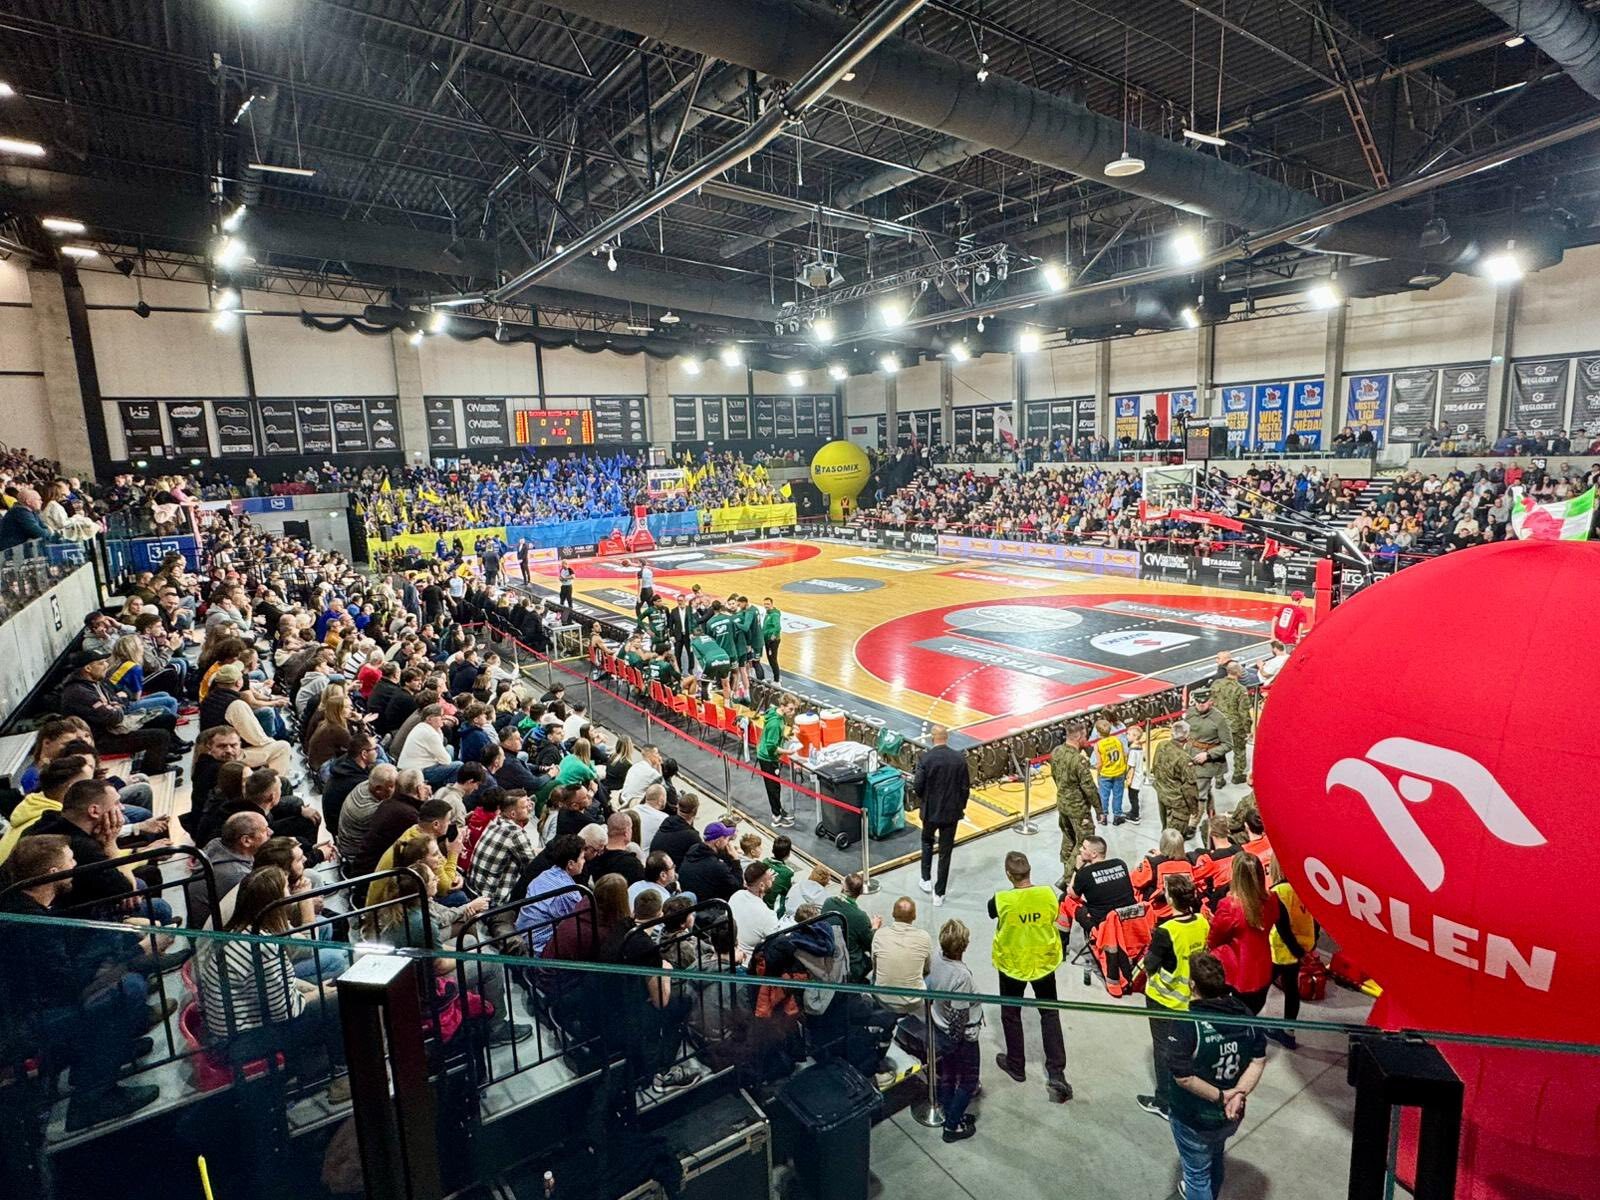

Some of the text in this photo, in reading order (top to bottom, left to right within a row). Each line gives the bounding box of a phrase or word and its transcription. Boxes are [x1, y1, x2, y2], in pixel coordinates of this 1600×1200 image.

[821, 464, 859, 473] TASOMIX
[1019, 912, 1042, 924] VIP
[1303, 856, 1557, 992] ORLEN
[1219, 1041, 1239, 1056] LISO
